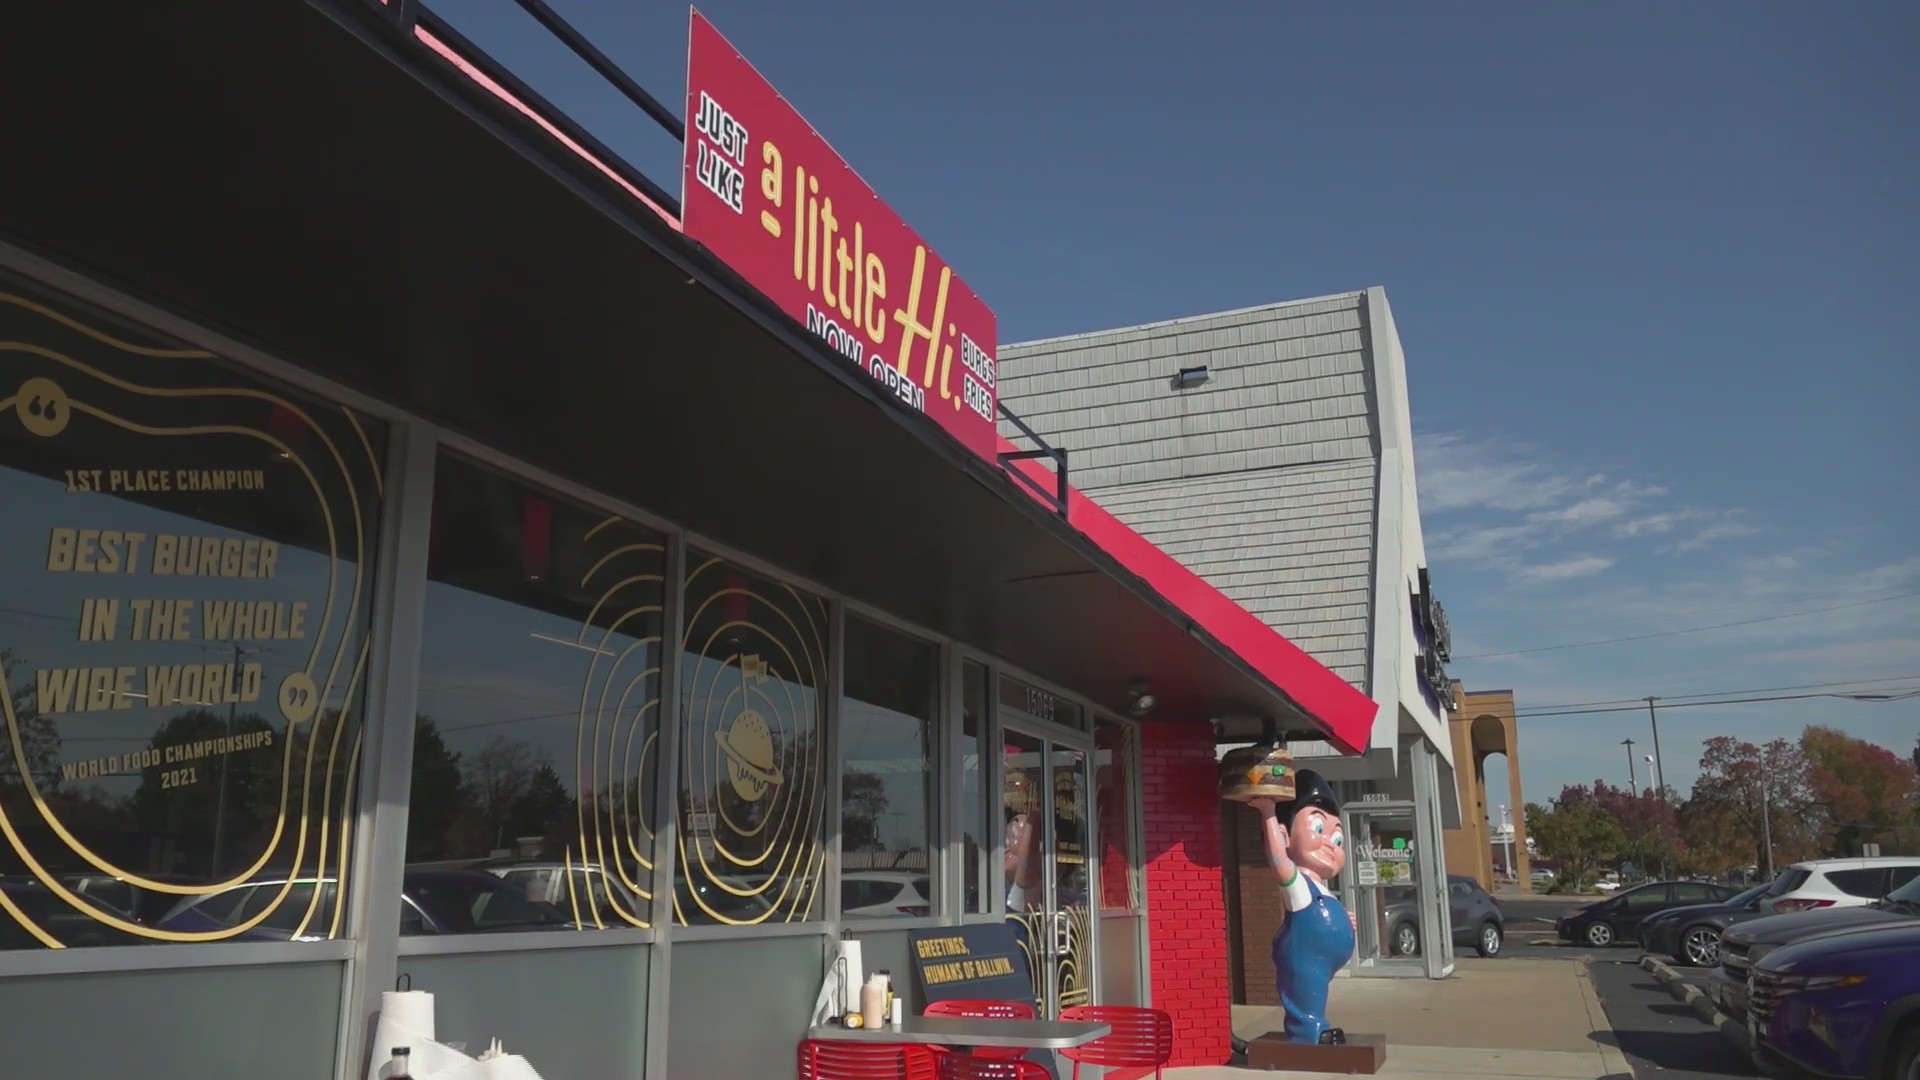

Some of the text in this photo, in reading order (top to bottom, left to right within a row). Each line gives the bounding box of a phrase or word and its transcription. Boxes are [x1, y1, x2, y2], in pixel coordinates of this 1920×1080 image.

[696, 90, 748, 167] JUST
[697, 139, 744, 215] LIKE
[761, 141, 783, 238] a
[794, 166, 886, 344] little
[961, 333, 995, 389] BURGS
[964, 373, 993, 422] FRIES
[65, 469, 265, 492] 1ST PLACE CHAMPION
[47, 528, 279, 578] BEST BURGER
[78, 599, 308, 641] IN THE WHOLE
[36, 662, 264, 715] WIDE WORLD
[62, 730, 273, 782] WORLD FOOD CHAMPIONSHIPS
[161, 767, 198, 789] 2021
[1356, 843, 1411, 859] Welcome
[916, 937, 970, 959] GREETINGS,
[923, 962, 964, 984] HUMANS
[963, 961, 975, 979] OF
